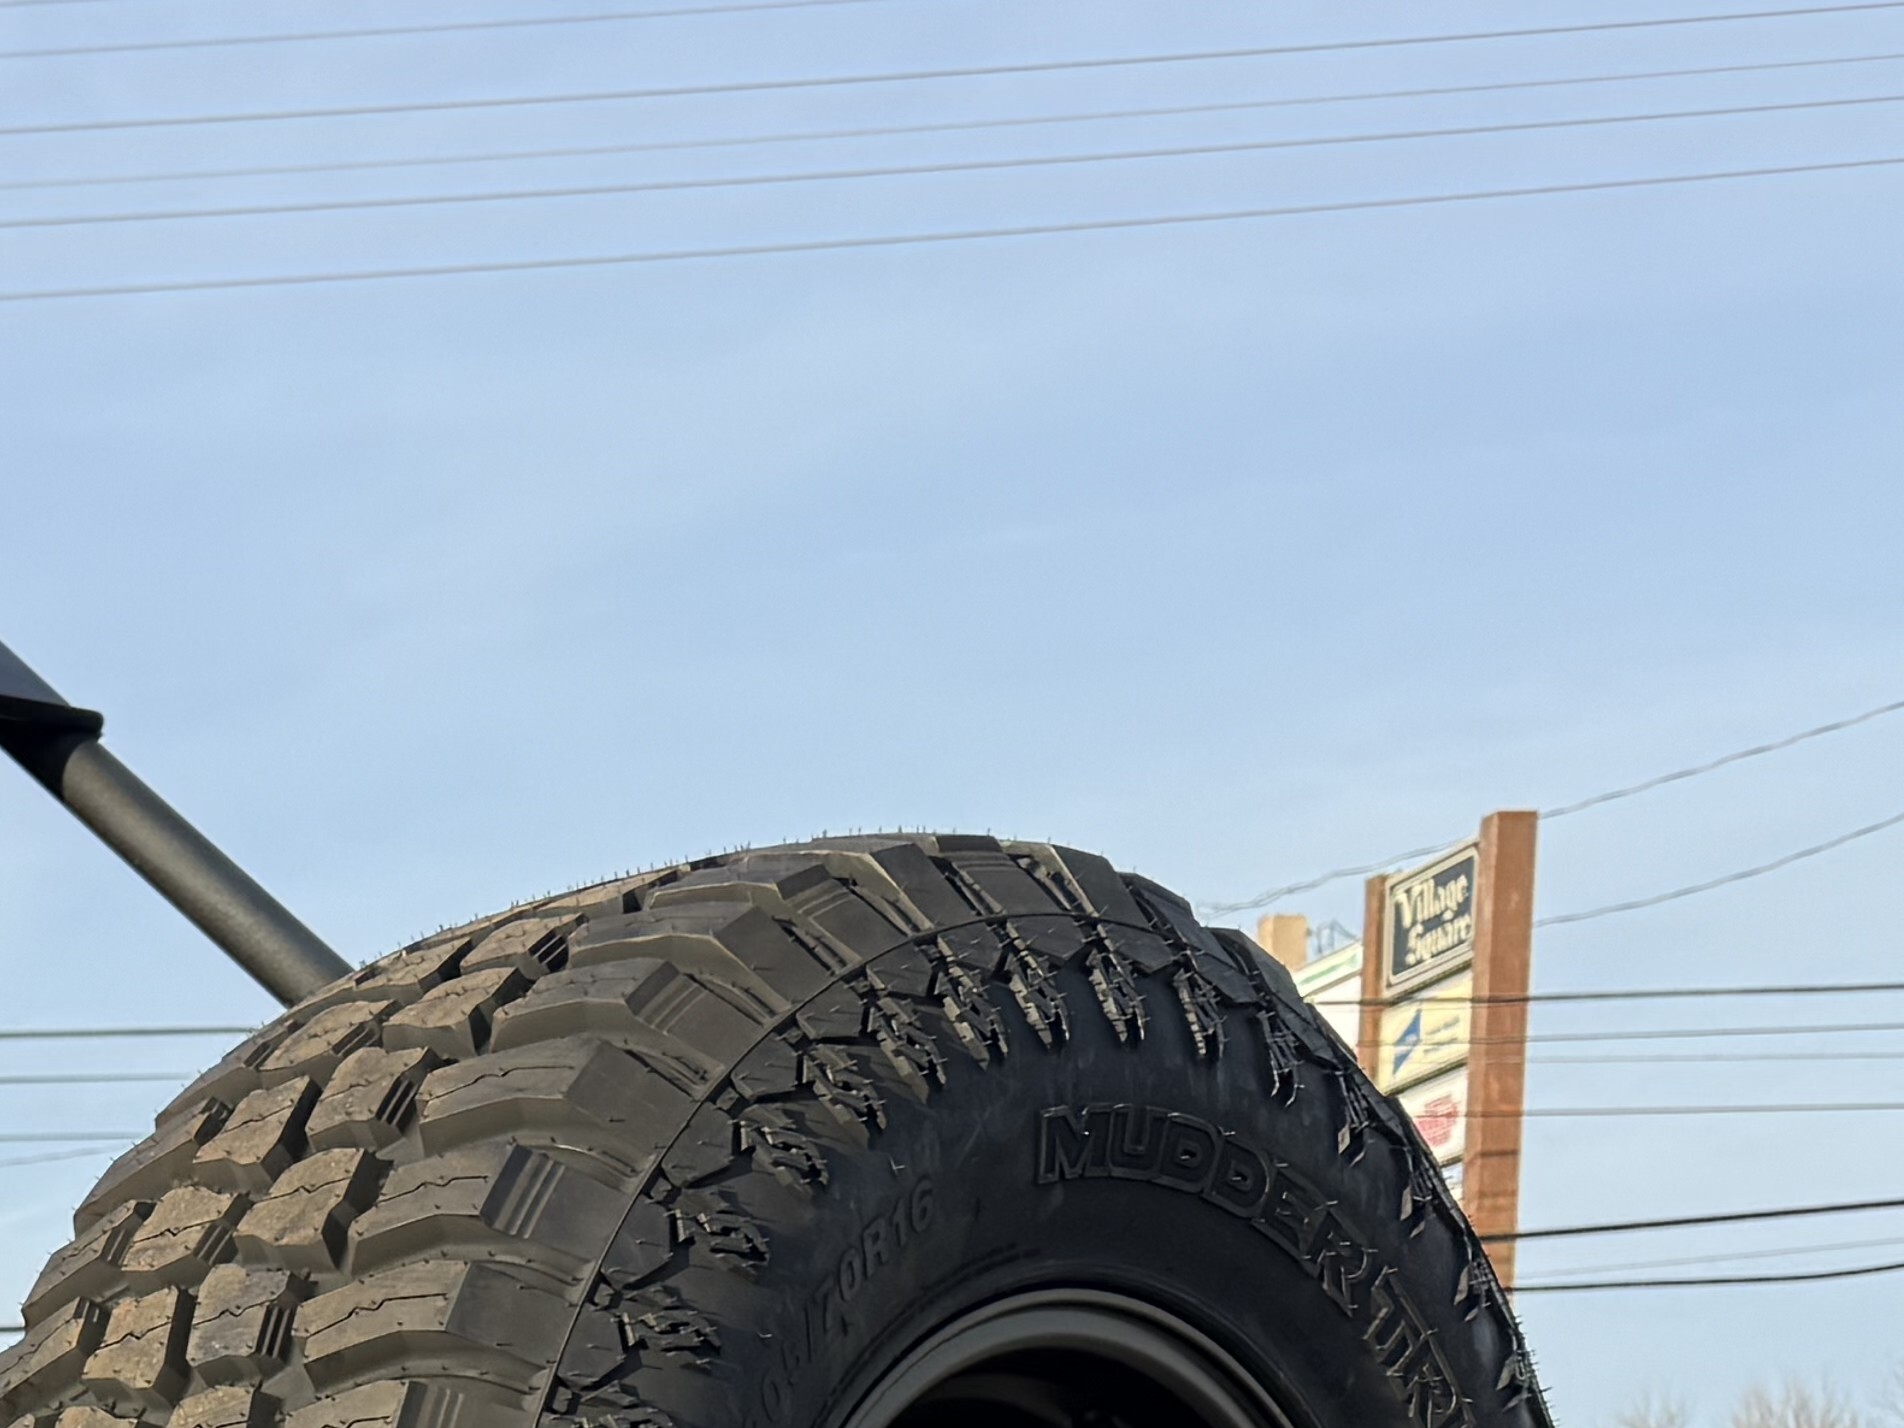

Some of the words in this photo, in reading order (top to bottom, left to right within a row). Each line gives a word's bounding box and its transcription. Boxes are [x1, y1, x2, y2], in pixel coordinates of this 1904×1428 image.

[1395, 873, 1470, 929] Village
[1405, 910, 1473, 966] Square
[1033, 1102, 1376, 1315] MUDDER
